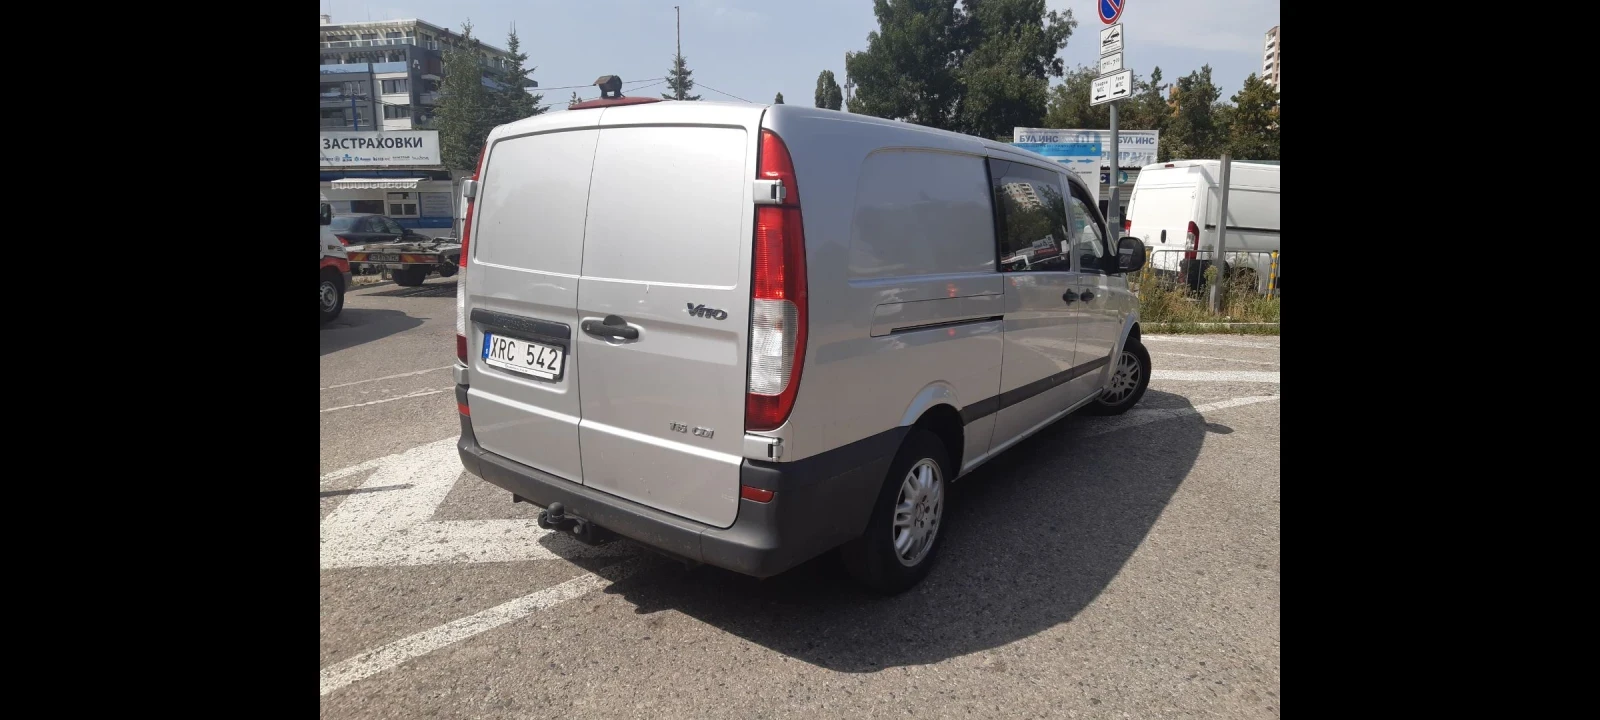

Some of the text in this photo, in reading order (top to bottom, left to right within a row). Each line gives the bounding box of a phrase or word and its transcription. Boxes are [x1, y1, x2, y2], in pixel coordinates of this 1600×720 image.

[323, 137, 423, 150] ЗАСТРАХОВКИ
[1019, 135, 1059, 144] БУЛ ИНС
[1118, 136, 1155, 145] БУЛ ИНС
[490, 336, 516, 362] XRC
[526, 343, 558, 371] 542
[691, 426, 715, 439] CDI
